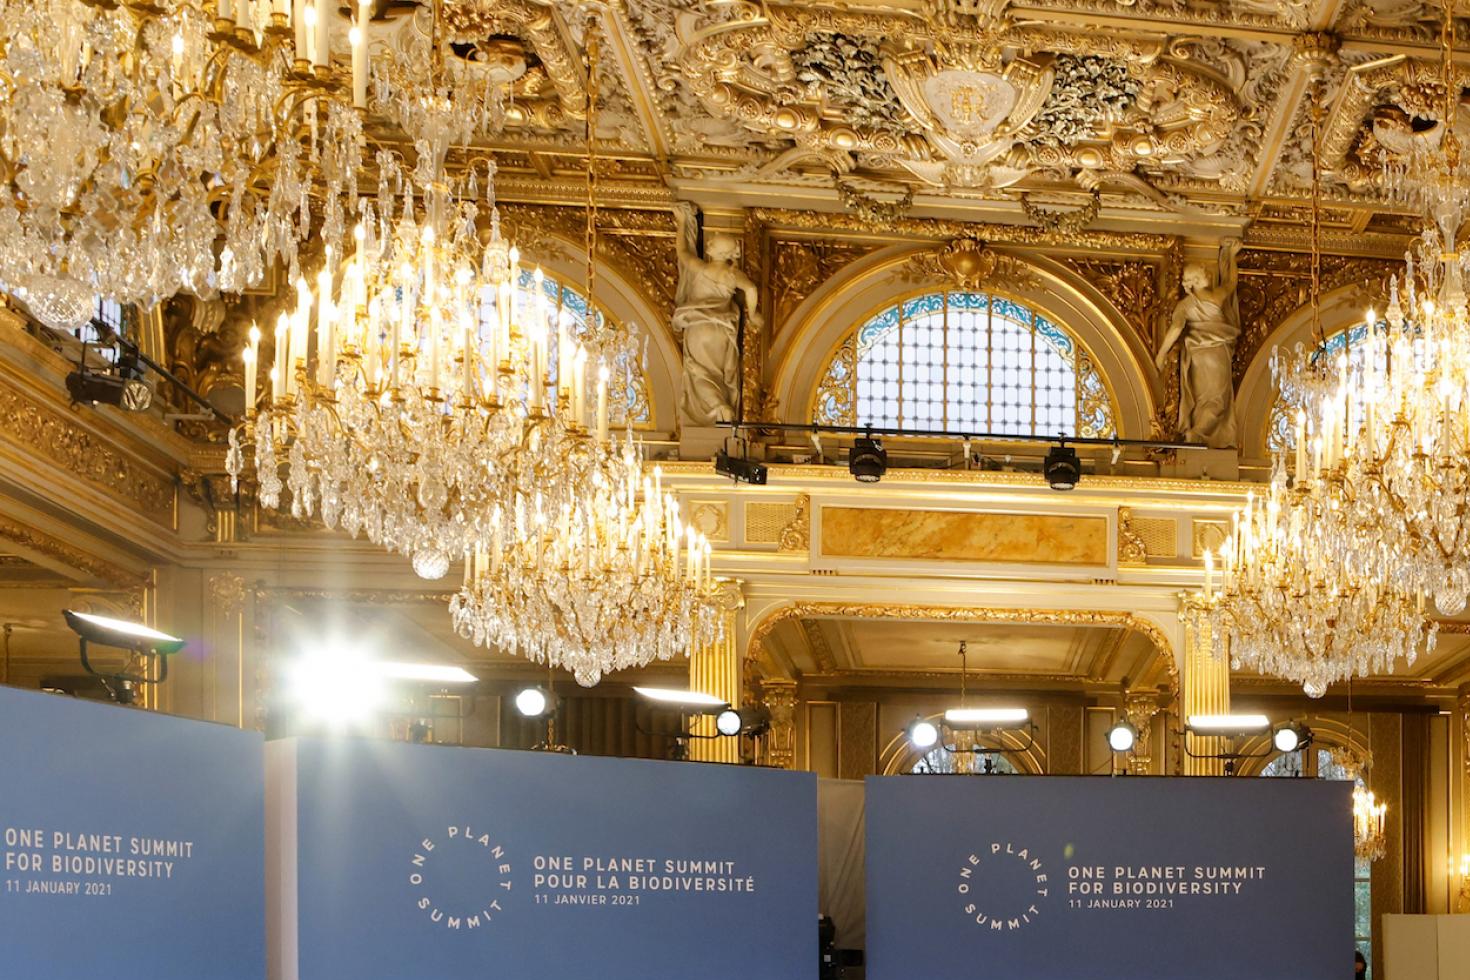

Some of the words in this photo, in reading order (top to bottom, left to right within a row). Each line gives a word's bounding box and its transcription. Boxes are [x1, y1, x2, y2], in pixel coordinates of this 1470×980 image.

[5, 828, 45, 848] ONE
[53, 831, 123, 854] PLANET
[130, 837, 194, 858] SUMMIT
[5, 852, 43, 872] FOR
[52, 854, 174, 878] BIODIVERSITY
[410, 838, 435, 885] ONE
[447, 825, 512, 892] PLANET
[533, 855, 574, 871] ONE
[583, 857, 657, 873] PLANET
[664, 859, 736, 875] SUMMIT
[990, 842, 1049, 898] PLANET
[533, 873, 588, 889] POUR
[597, 875, 621, 890] LA
[629, 875, 755, 892] BIODIVERSITÉ
[957, 853, 981, 895] ONE
[1068, 866, 1106, 879] ONE
[1114, 866, 1187, 879] PLANET
[1194, 866, 1266, 880] SUMMIT
[6, 879, 21, 892] 11
[25, 880, 81, 895] JANUARY
[85, 882, 112, 896] 2021
[534, 894, 549, 905] 11
[554, 894, 608, 905] JANVIER
[611, 894, 641, 906] 2021
[1068, 882, 1104, 895] FOR
[1113, 882, 1242, 895] BIODIVERSITY
[417, 897, 503, 930] SUMMIT
[964, 903, 1040, 931] SUMMIT
[1068, 899, 1083, 909] 11
[1087, 899, 1142, 909] JANUARY
[1145, 899, 1174, 909] 2021
